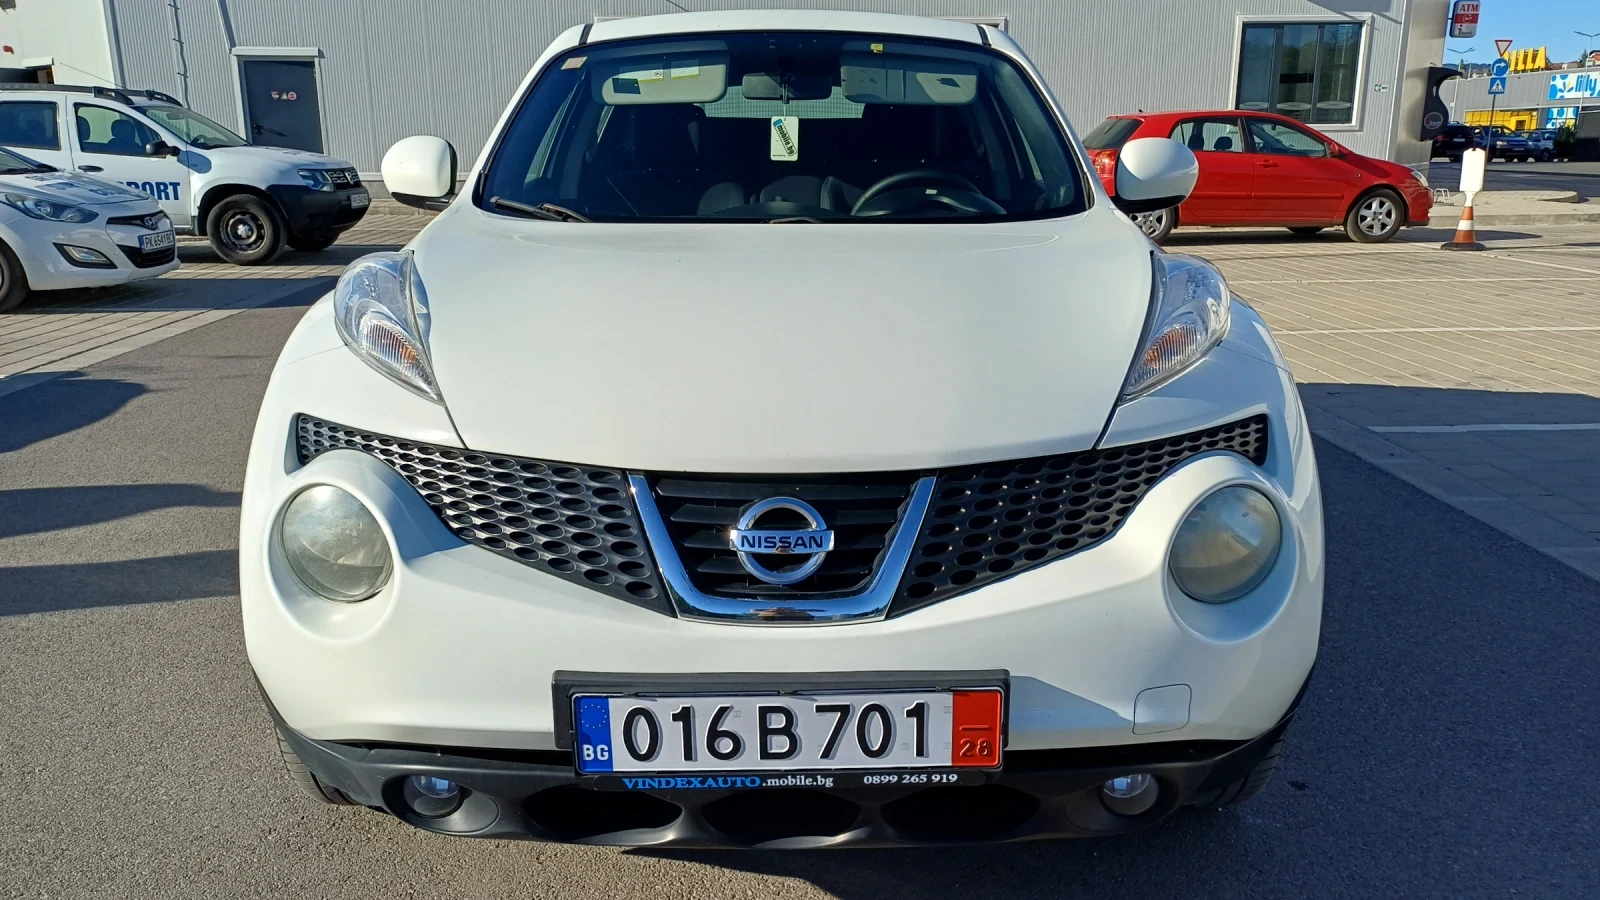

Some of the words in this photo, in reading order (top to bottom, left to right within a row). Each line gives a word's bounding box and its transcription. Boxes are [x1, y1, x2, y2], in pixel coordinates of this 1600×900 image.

[1459, 3, 1479, 12] ATM
[776, 124, 795, 156] mobile.bg
[741, 534, 823, 549] NISSAN
[582, 744, 609, 761] BG
[959, 737, 992, 757] 28
[863, 775, 898, 785] 0899
[901, 774, 928, 783] 265
[931, 773, 958, 783] 919
